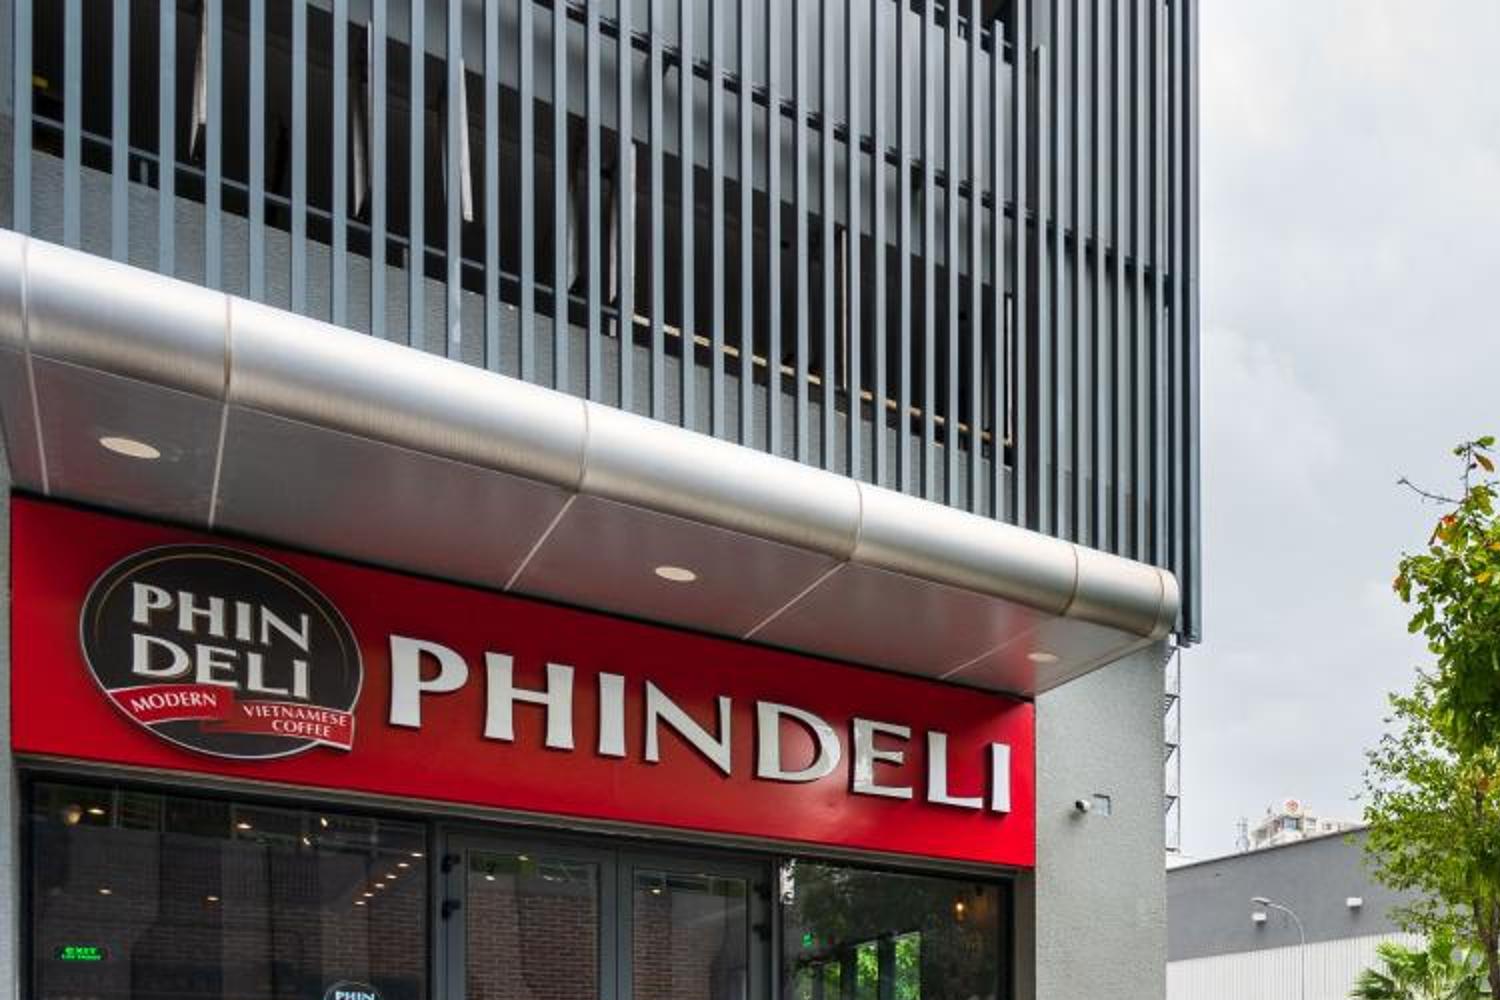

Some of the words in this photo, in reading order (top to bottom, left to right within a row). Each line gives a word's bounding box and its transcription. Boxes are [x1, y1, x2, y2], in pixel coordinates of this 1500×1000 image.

[132, 582, 309, 652] PHIN
[132, 633, 308, 698] DELI
[130, 692, 218, 713] MODERN
[243, 703, 348, 726] VIETNAMESE
[389, 634, 1012, 813] PHINDELI
[271, 719, 331, 737] COFFEE
